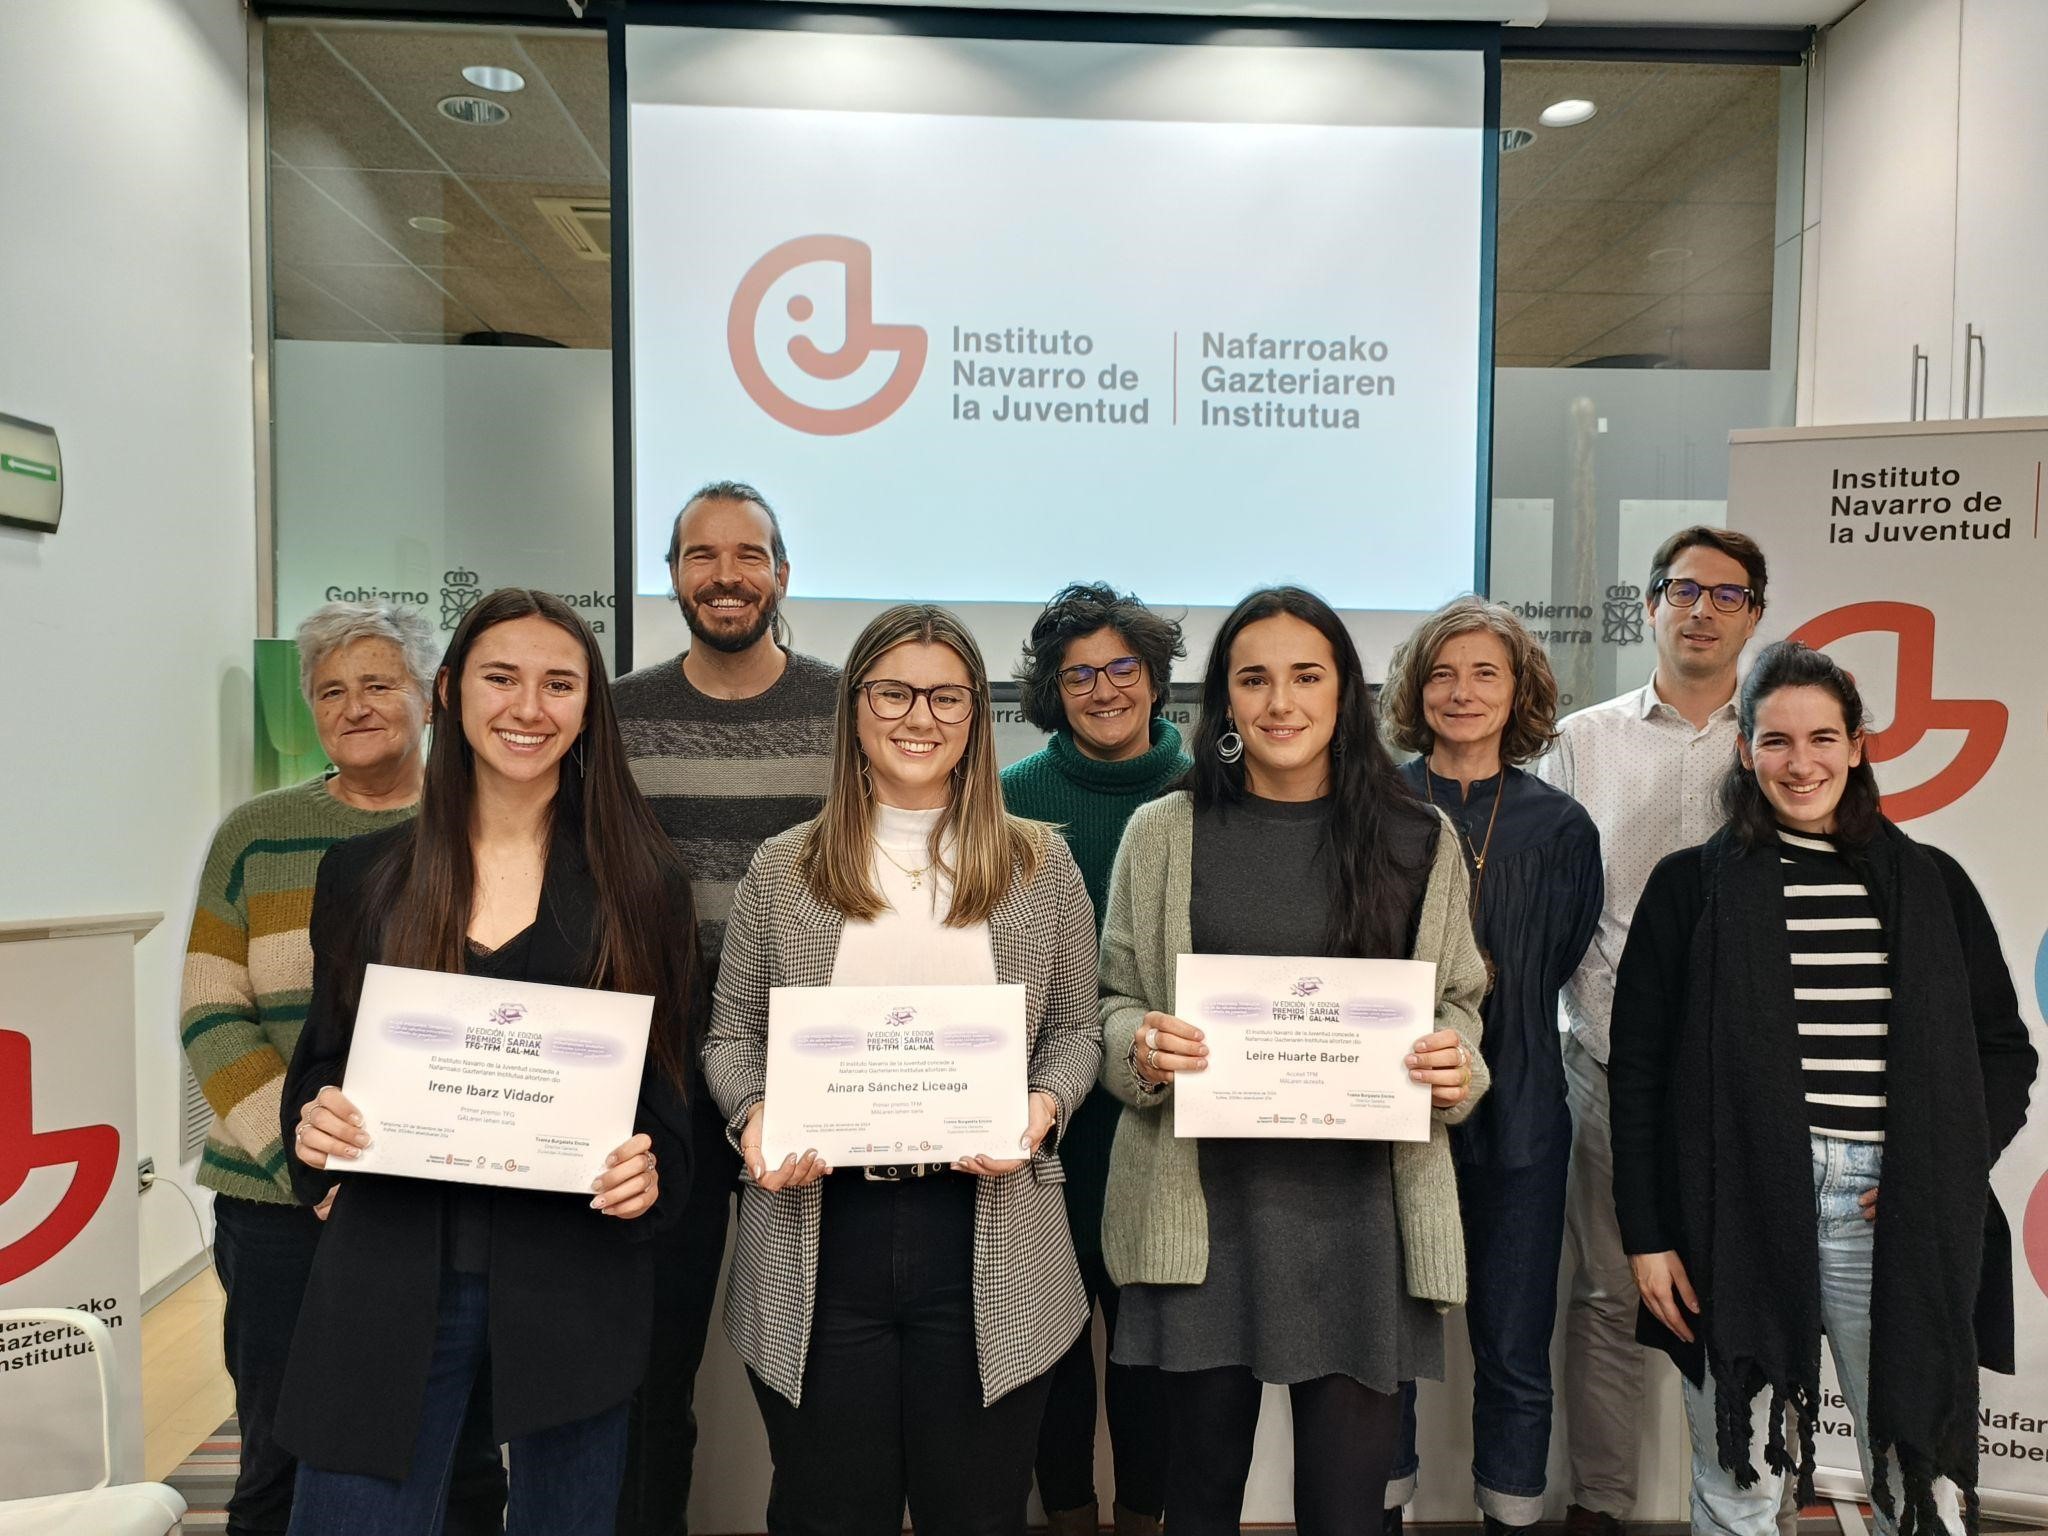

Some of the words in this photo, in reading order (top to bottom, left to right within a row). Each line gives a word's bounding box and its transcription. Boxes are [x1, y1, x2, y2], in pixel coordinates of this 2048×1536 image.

[953, 325, 1093, 355] Instituto
[1202, 332, 1388, 362] Nafarroako
[953, 359, 1086, 389] Navarro
[1098, 363, 1139, 391] de
[1201, 365, 1395, 396] Gazteriaren
[953, 394, 981, 420] la
[992, 395, 1149, 424] Juventud
[1202, 400, 1360, 429] Institutua
[1832, 466, 1960, 489] Instituto
[1831, 495, 1951, 516] Navarro
[1963, 491, 2002, 513] de
[1829, 523, 1854, 543] la
[1864, 518, 2011, 543] Juventud
[1496, 600, 1593, 619] obierno
[1272, 1007, 1305, 1015] PREMIOS
[1309, 1008, 1340, 1016] SARIAK
[1309, 1015, 1340, 1023] GAL-MAL
[465, 1034, 501, 1044] PREMIOS
[467, 1026, 475, 1034] IV
[465, 1041, 501, 1052] TFG-TFM
[507, 1038, 541, 1049] SARIAK
[867, 1037, 899, 1045] PREMIOS
[867, 1044, 899, 1052] TFG-TFM
[506, 1047, 540, 1057] GAL-MAL
[1246, 1050, 1275, 1061] Leire
[1278, 1051, 1317, 1062] Huarte
[1320, 1052, 1360, 1063] Barber
[428, 1080, 463, 1094] Irene
[466, 1084, 499, 1098] Ibarz
[503, 1088, 555, 1104] Vidador
[827, 1082, 865, 1093] Ainara
[868, 1081, 919, 1093] Sánchez
[922, 1081, 968, 1093] Liceaga
[0, 1314, 123, 1353] azteriaen
[0, 1341, 97, 1373] nstitutua
[1978, 1435, 2048, 1463] Gobe
